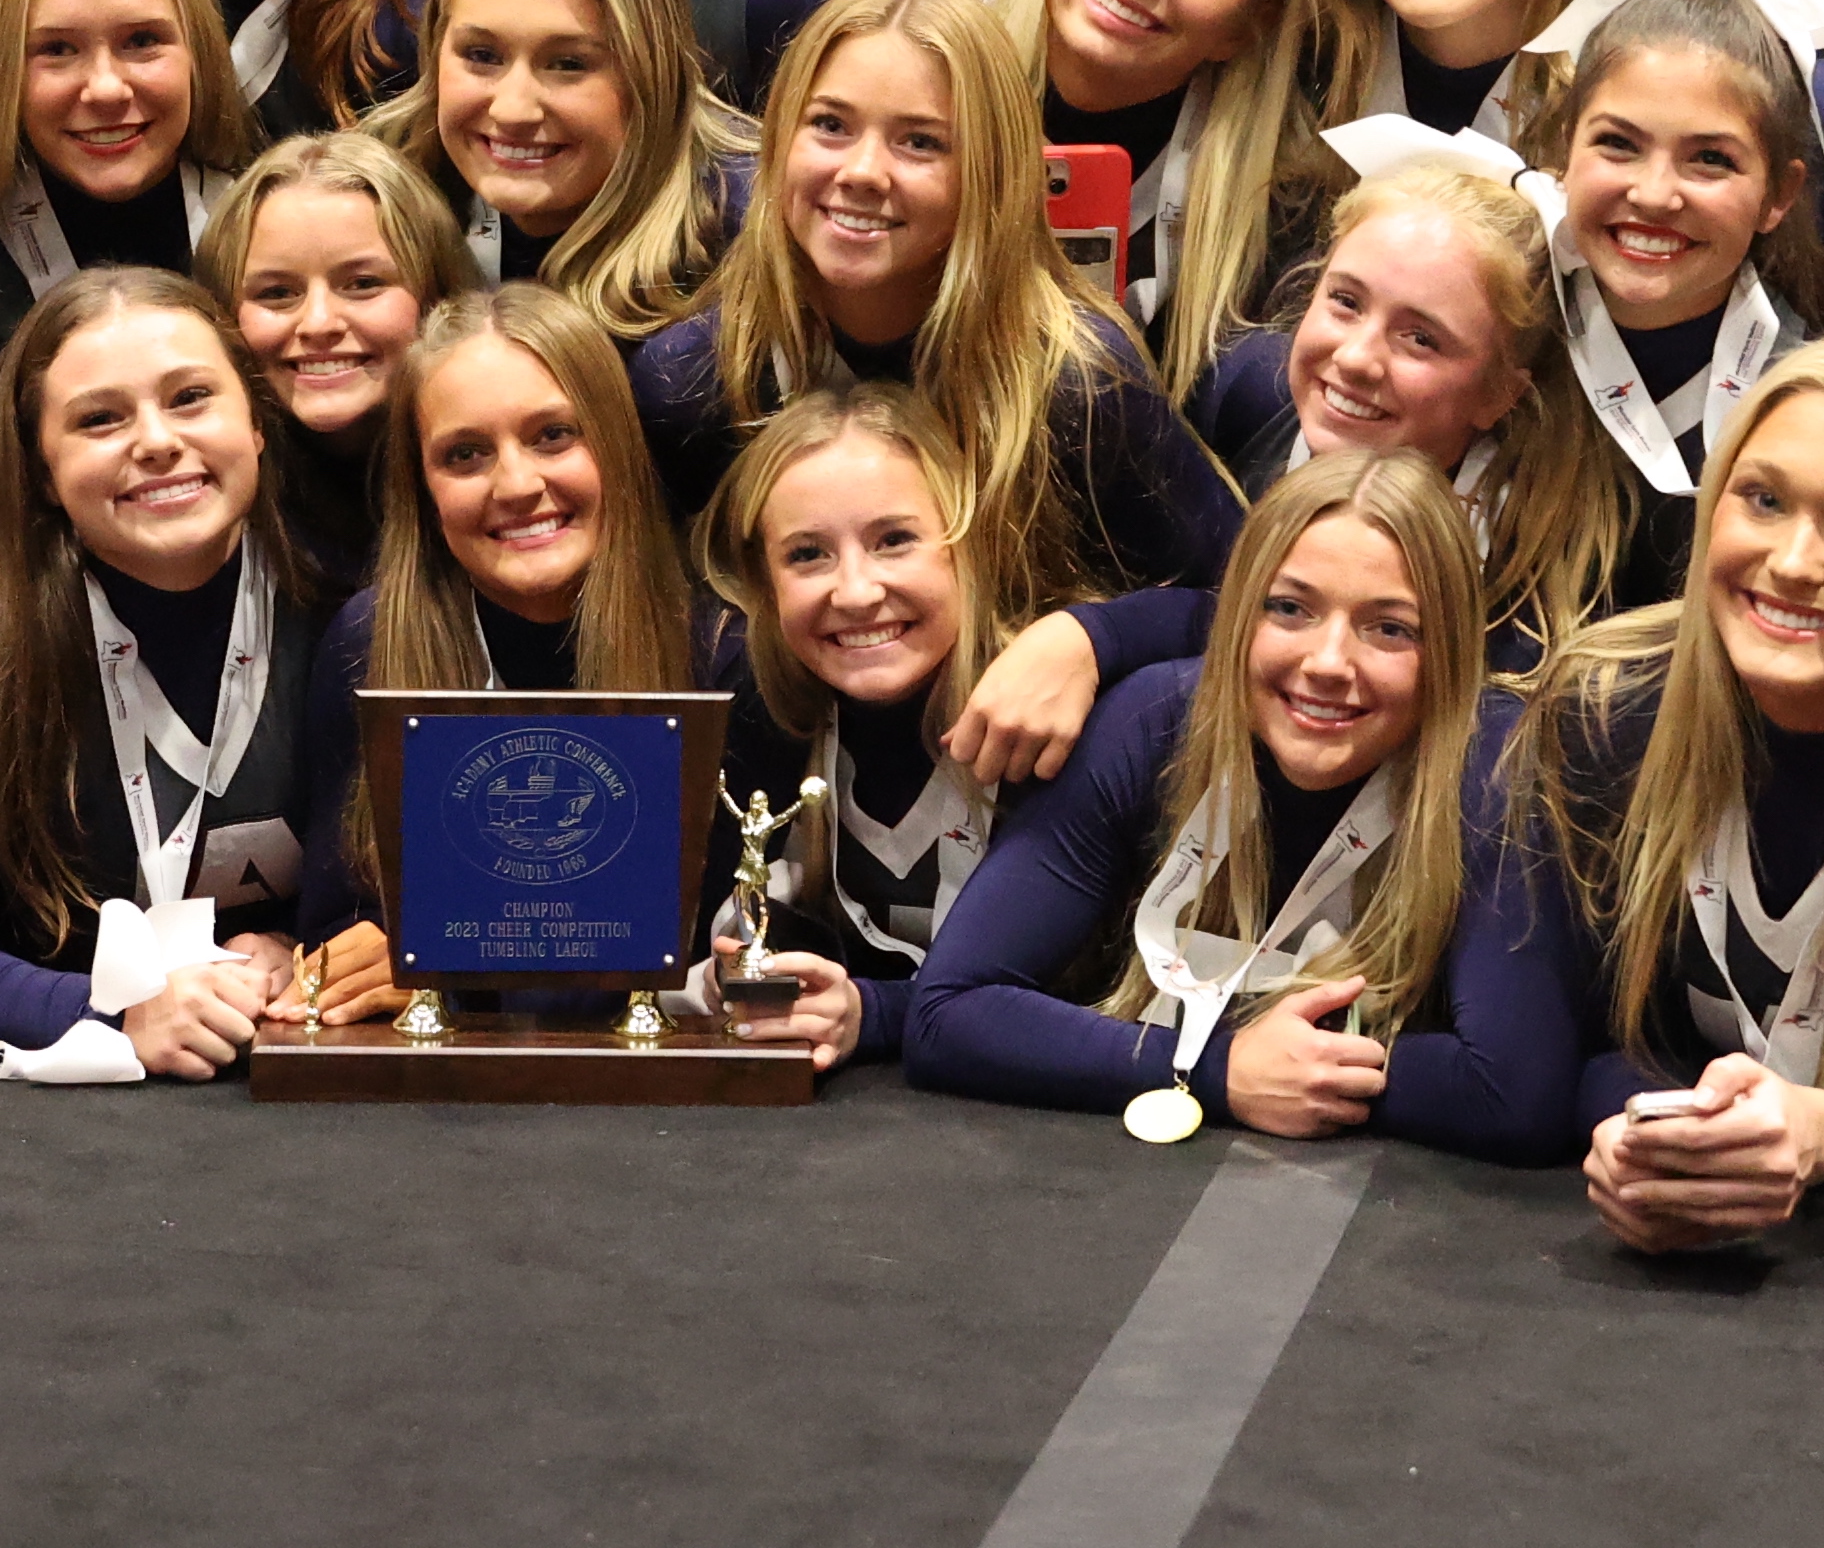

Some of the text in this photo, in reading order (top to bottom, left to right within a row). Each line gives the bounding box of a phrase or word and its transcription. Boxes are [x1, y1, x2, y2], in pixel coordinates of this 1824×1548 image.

[500, 735, 560, 758] ATHLETIC
[565, 740, 627, 800] CONFERENCE
[503, 902, 574, 918] CHAMPION
[445, 922, 632, 938] 2023 CHEER COMPETITION
[480, 941, 546, 958] TUMBLING
